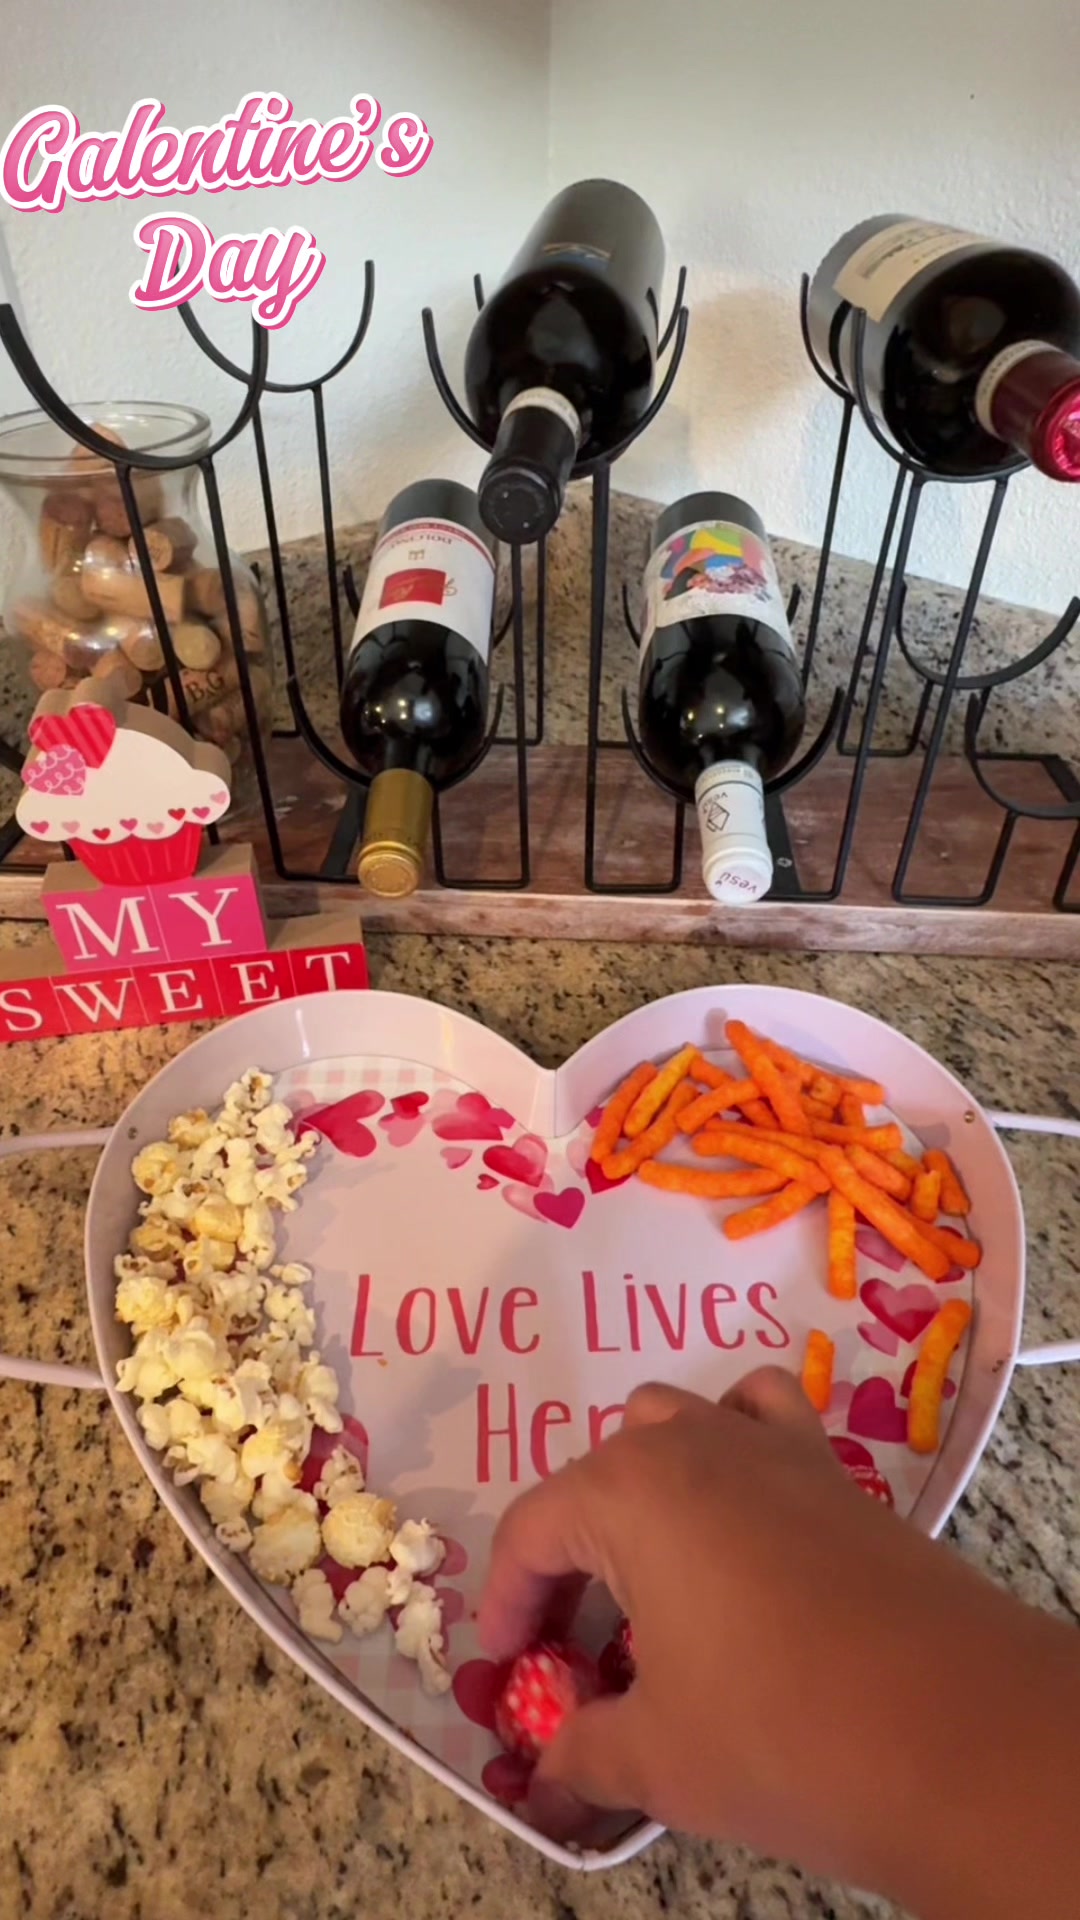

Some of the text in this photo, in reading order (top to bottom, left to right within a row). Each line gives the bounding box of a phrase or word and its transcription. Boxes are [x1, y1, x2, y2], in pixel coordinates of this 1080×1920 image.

[56, 887, 239, 960] MY
[0, 951, 350, 1032] SWEET
[350, 1270, 790, 1358] Love Lives
[476, 1382, 628, 1483] Her
